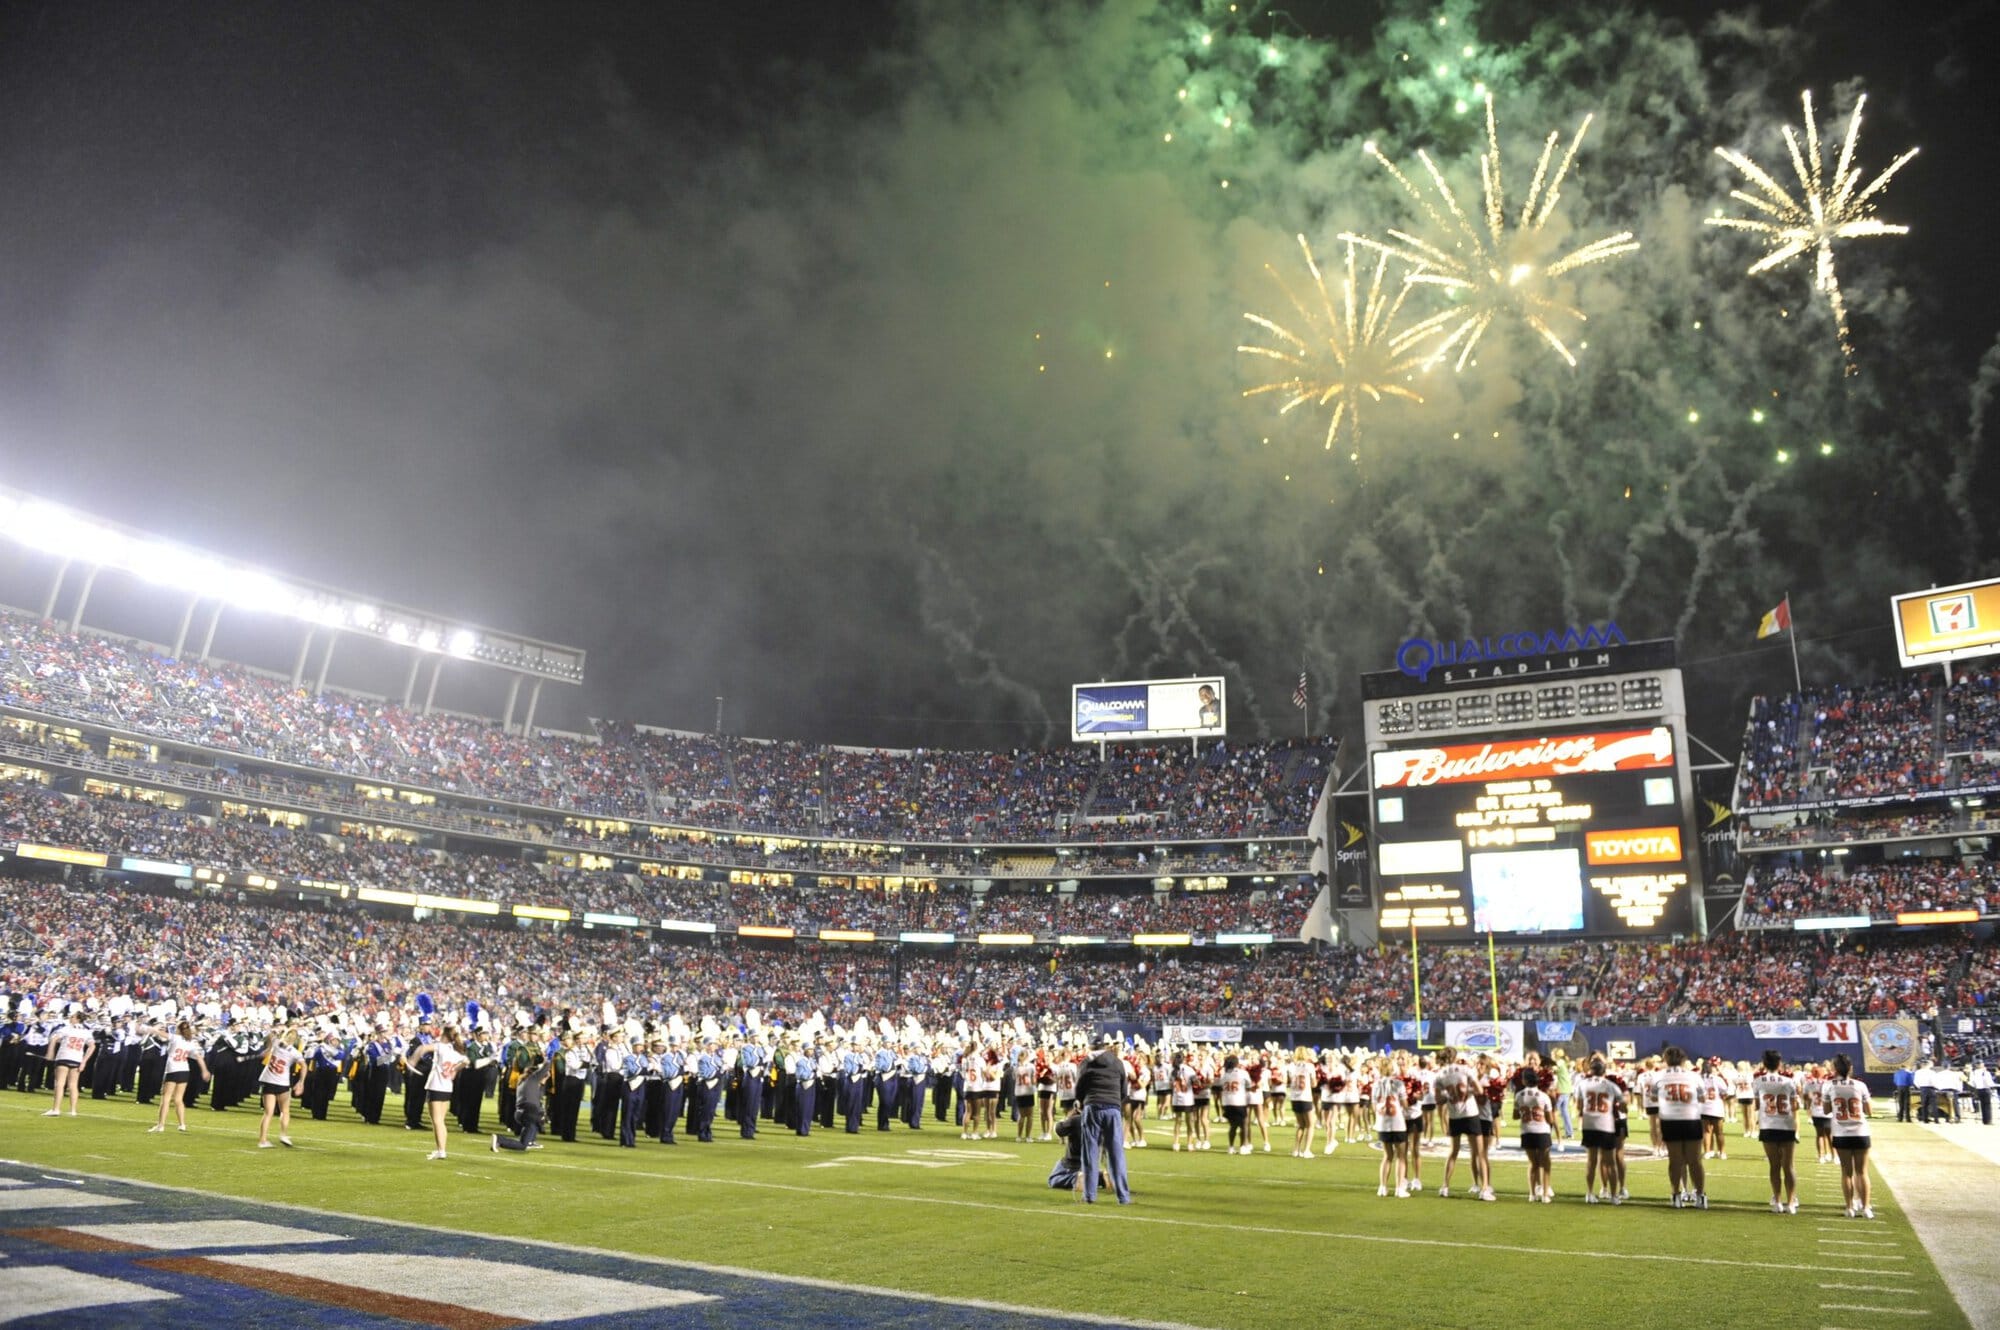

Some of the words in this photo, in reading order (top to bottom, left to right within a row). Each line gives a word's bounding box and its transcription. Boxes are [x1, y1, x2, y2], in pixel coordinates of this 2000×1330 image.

[1939, 603, 1963, 630] 7
[1397, 621, 1629, 683] QUALCOMM
[1444, 653, 1610, 682] STADIUM
[1080, 700, 1145, 716] QUALCOMM
[1401, 737, 1595, 786] Budweiser
[1591, 836, 1678, 857] TOYOTA
[1701, 829, 1737, 843] Sprint
[1337, 849, 1367, 863] Sprint
[1826, 1022, 1849, 1041] N
[1586, 1090, 1609, 1113] 36
[1664, 1083, 1692, 1104] 36
[1834, 1097, 1861, 1120] 36
